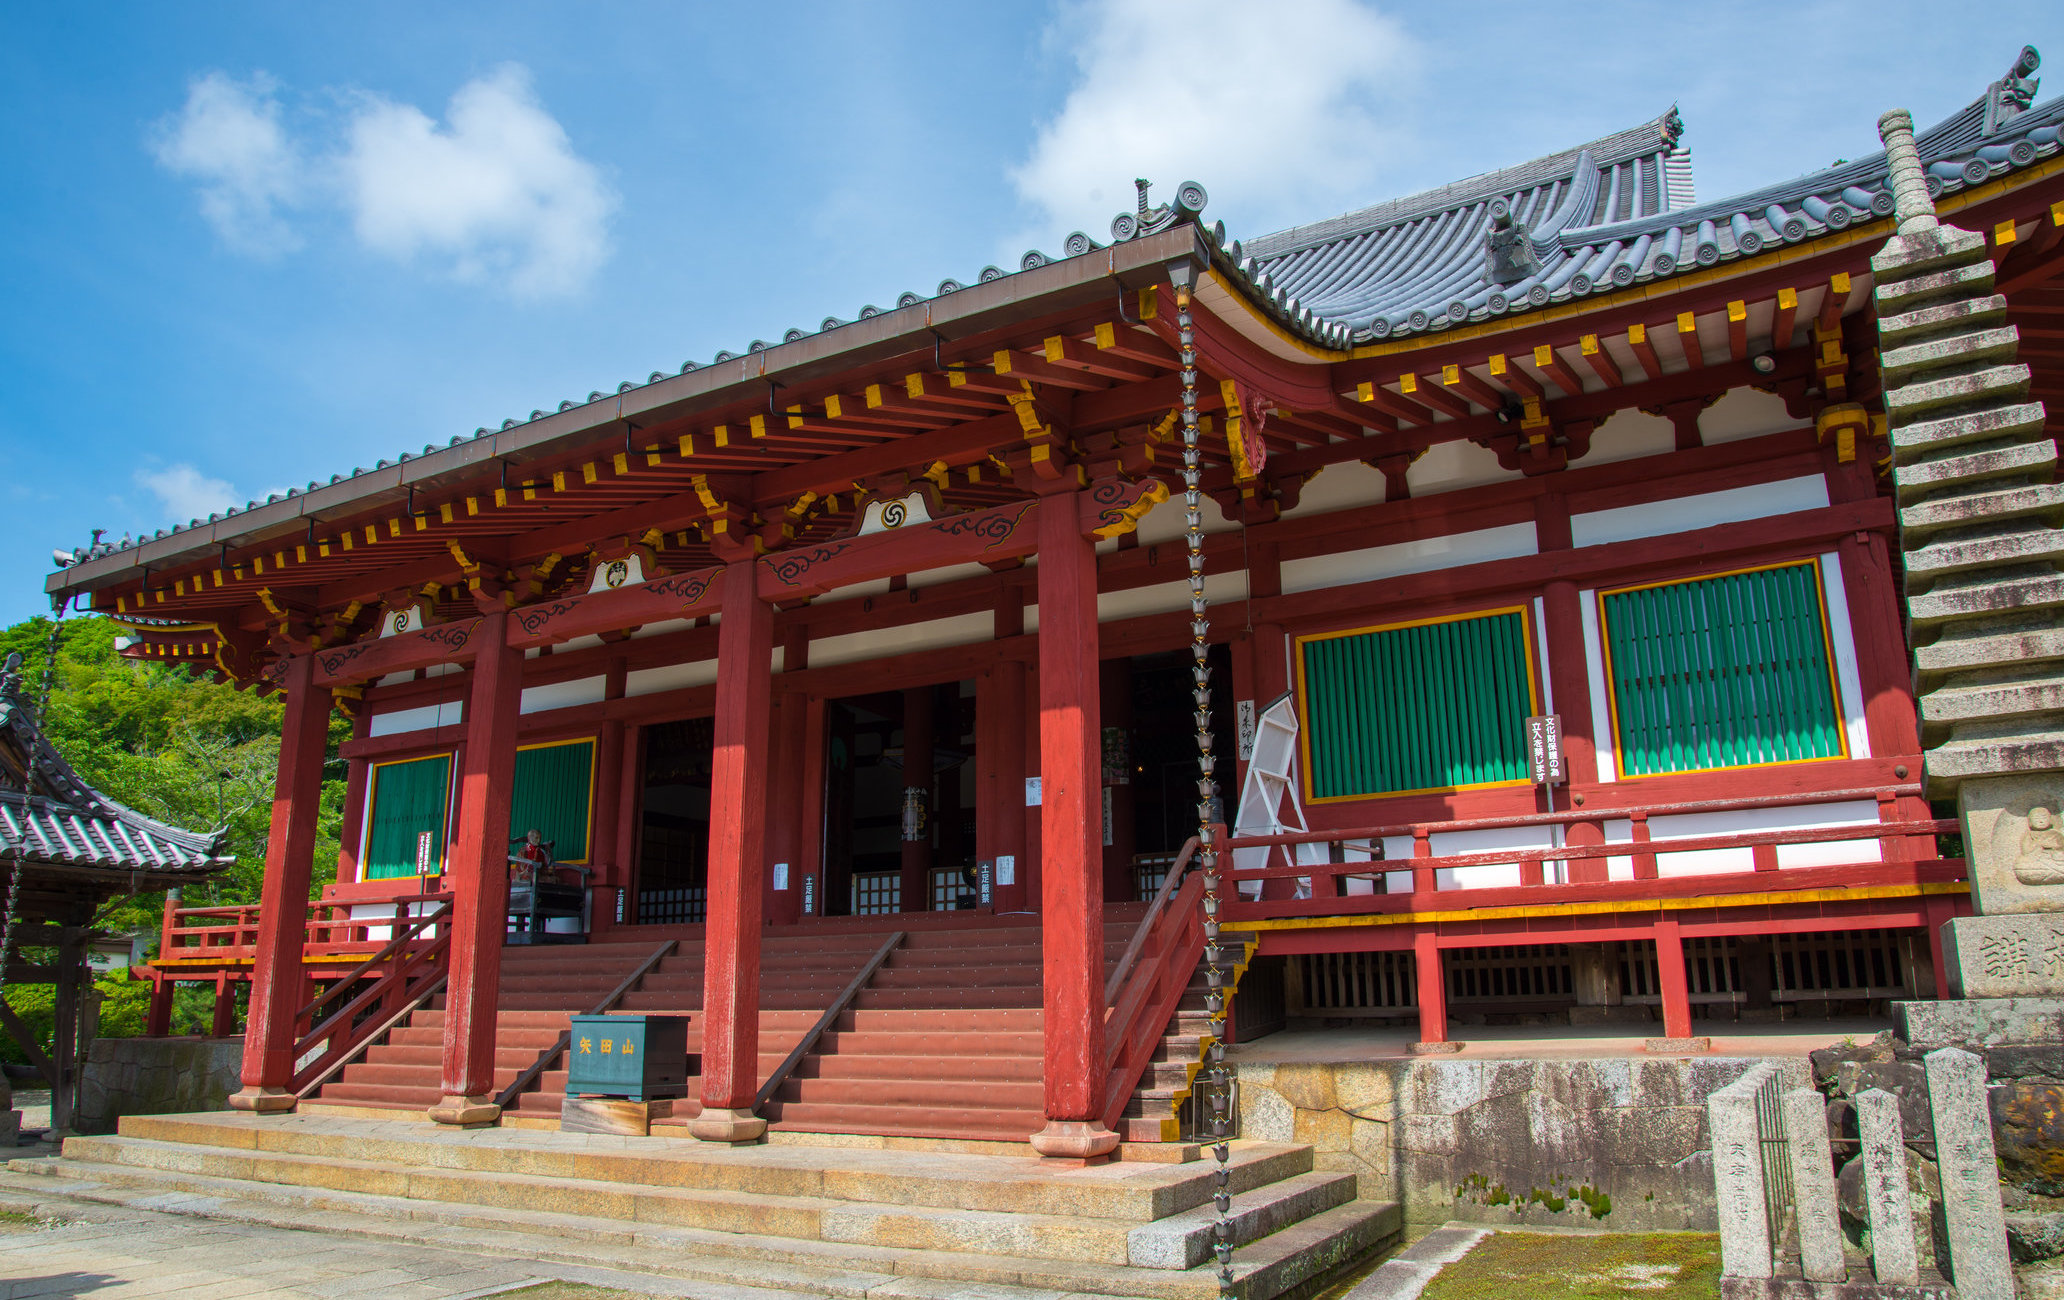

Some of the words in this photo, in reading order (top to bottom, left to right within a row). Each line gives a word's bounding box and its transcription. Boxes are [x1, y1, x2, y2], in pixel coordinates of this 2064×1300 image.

[1240, 701, 1254, 755] 御朱印所
[1545, 717, 1560, 777] 文化財保護の為
[1532, 722, 1545, 782] 立入を禁じます
[805, 875, 813, 912] 土足厳禁
[981, 864, 989, 903] 土足厳禁
[579, 1036, 634, 1055] 矢田山
